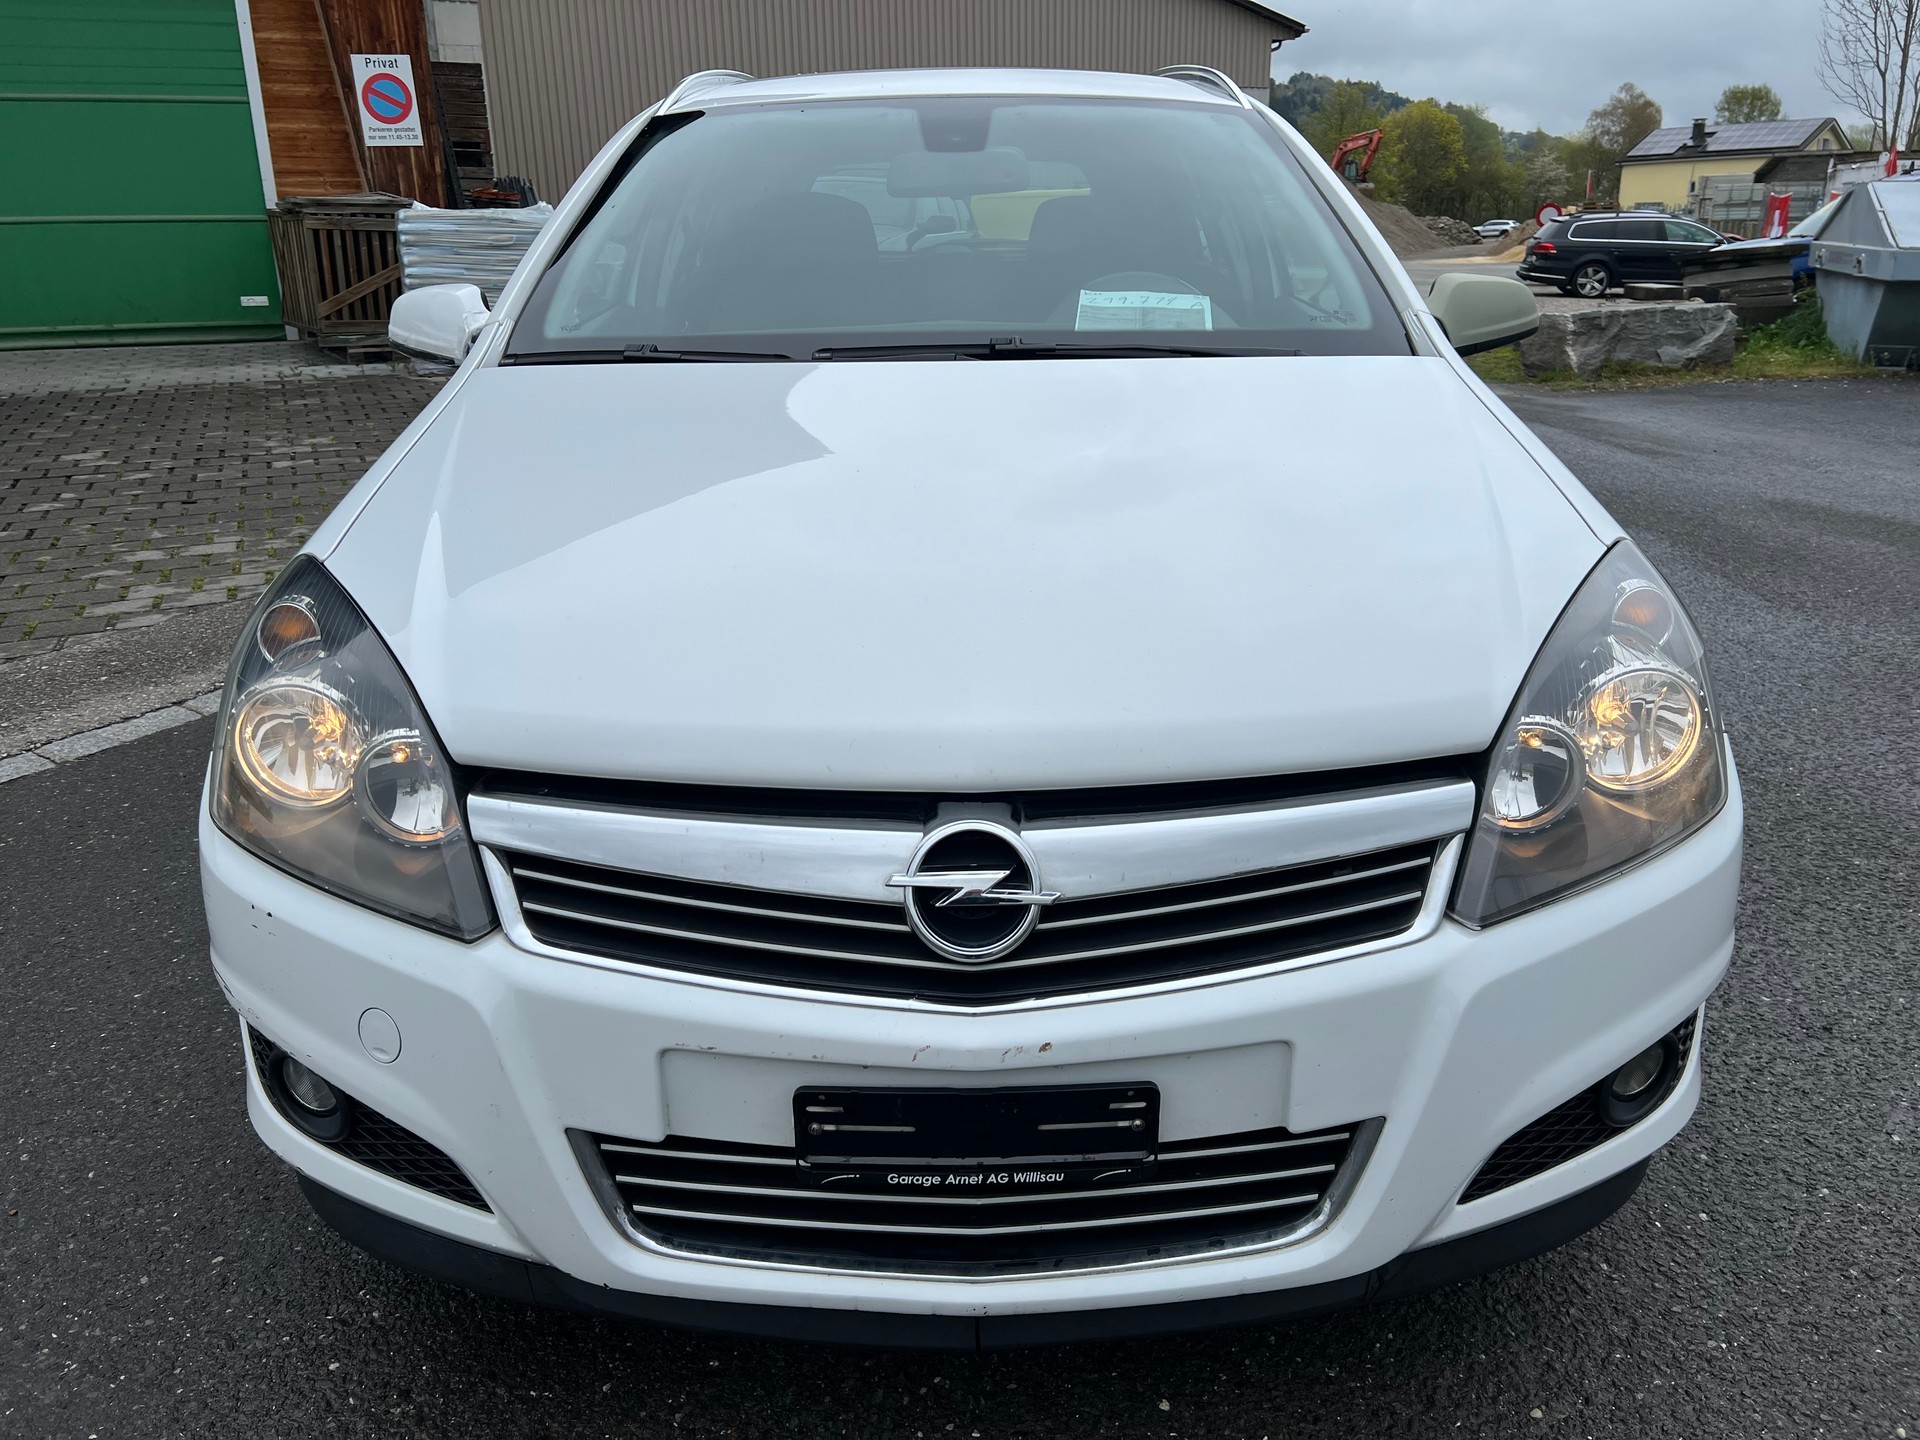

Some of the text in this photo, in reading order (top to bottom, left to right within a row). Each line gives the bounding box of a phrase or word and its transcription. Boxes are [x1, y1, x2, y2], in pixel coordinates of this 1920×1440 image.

[364, 57, 399, 69] Privat
[887, 1171, 1065, 1186] Garage Arnet AG Willisau
